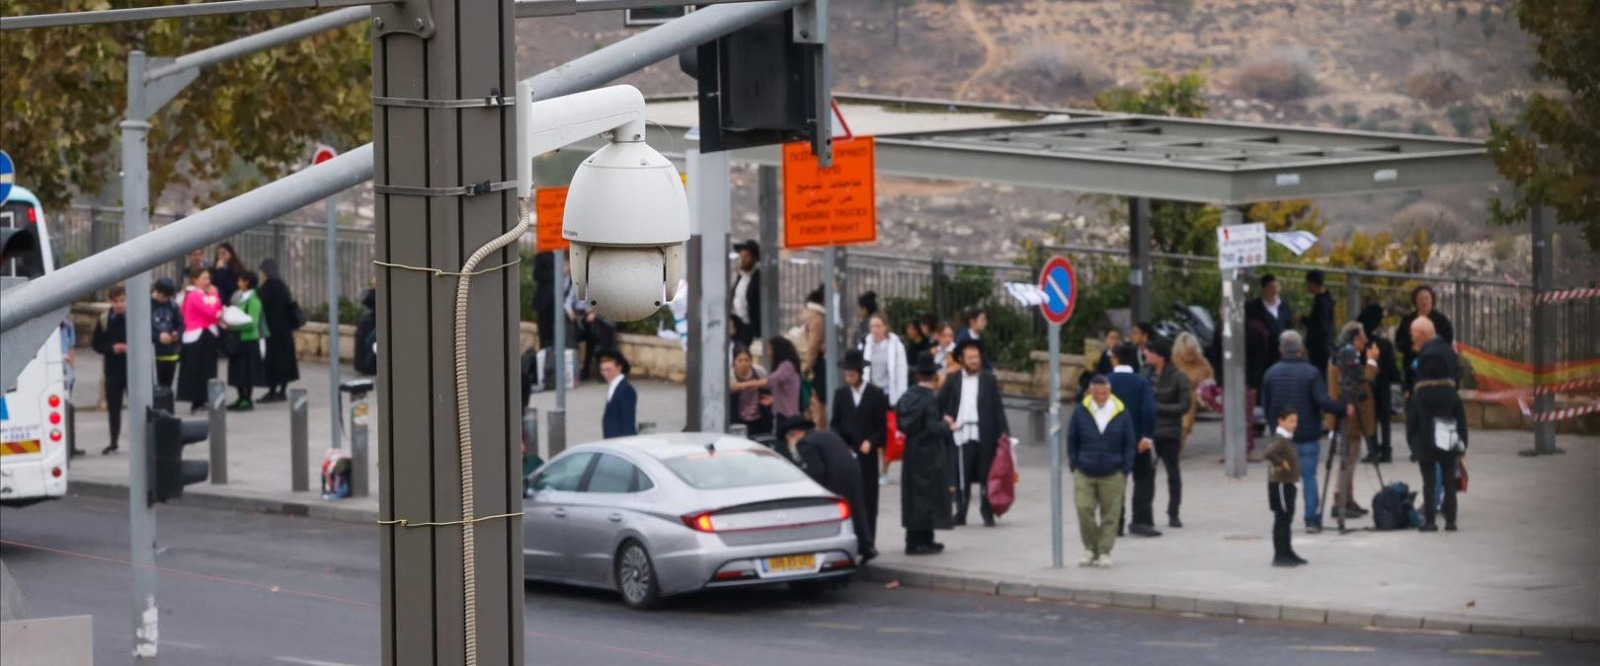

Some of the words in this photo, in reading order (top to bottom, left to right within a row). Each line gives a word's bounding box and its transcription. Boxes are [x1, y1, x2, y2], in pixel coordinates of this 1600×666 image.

[791, 210, 830, 221] MERGING
[834, 207, 868, 218] TRUCKS
[800, 225, 828, 235] FROM
[830, 222, 859, 234] RIGHT
